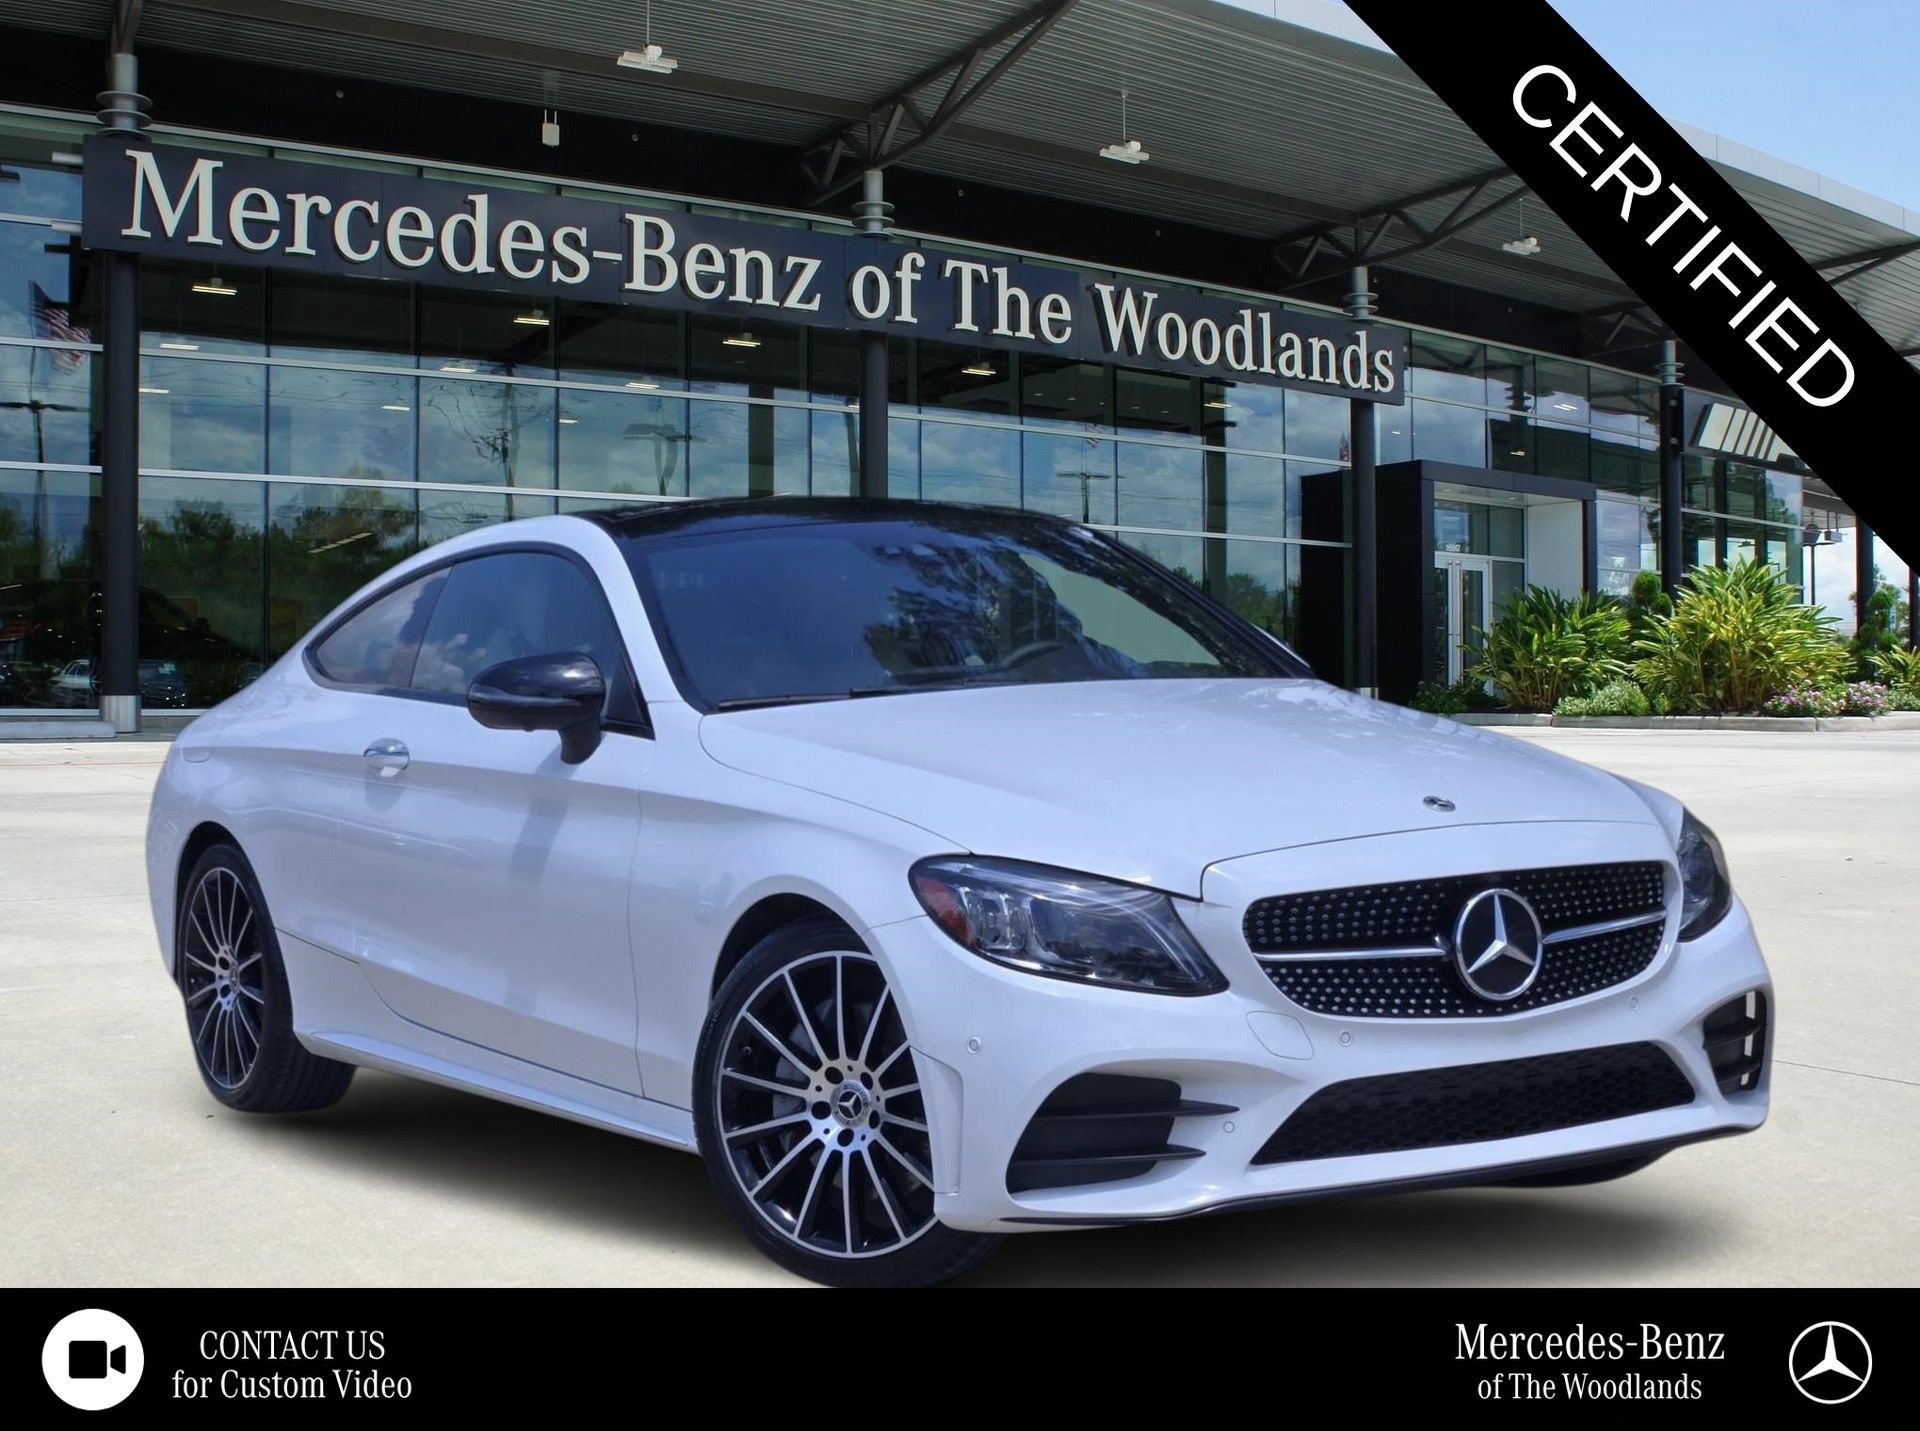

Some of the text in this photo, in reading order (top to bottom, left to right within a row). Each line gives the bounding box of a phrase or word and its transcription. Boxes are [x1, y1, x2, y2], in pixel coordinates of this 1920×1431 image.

[121, 149, 1397, 394] Mercedes-Benz of The Woodlands
